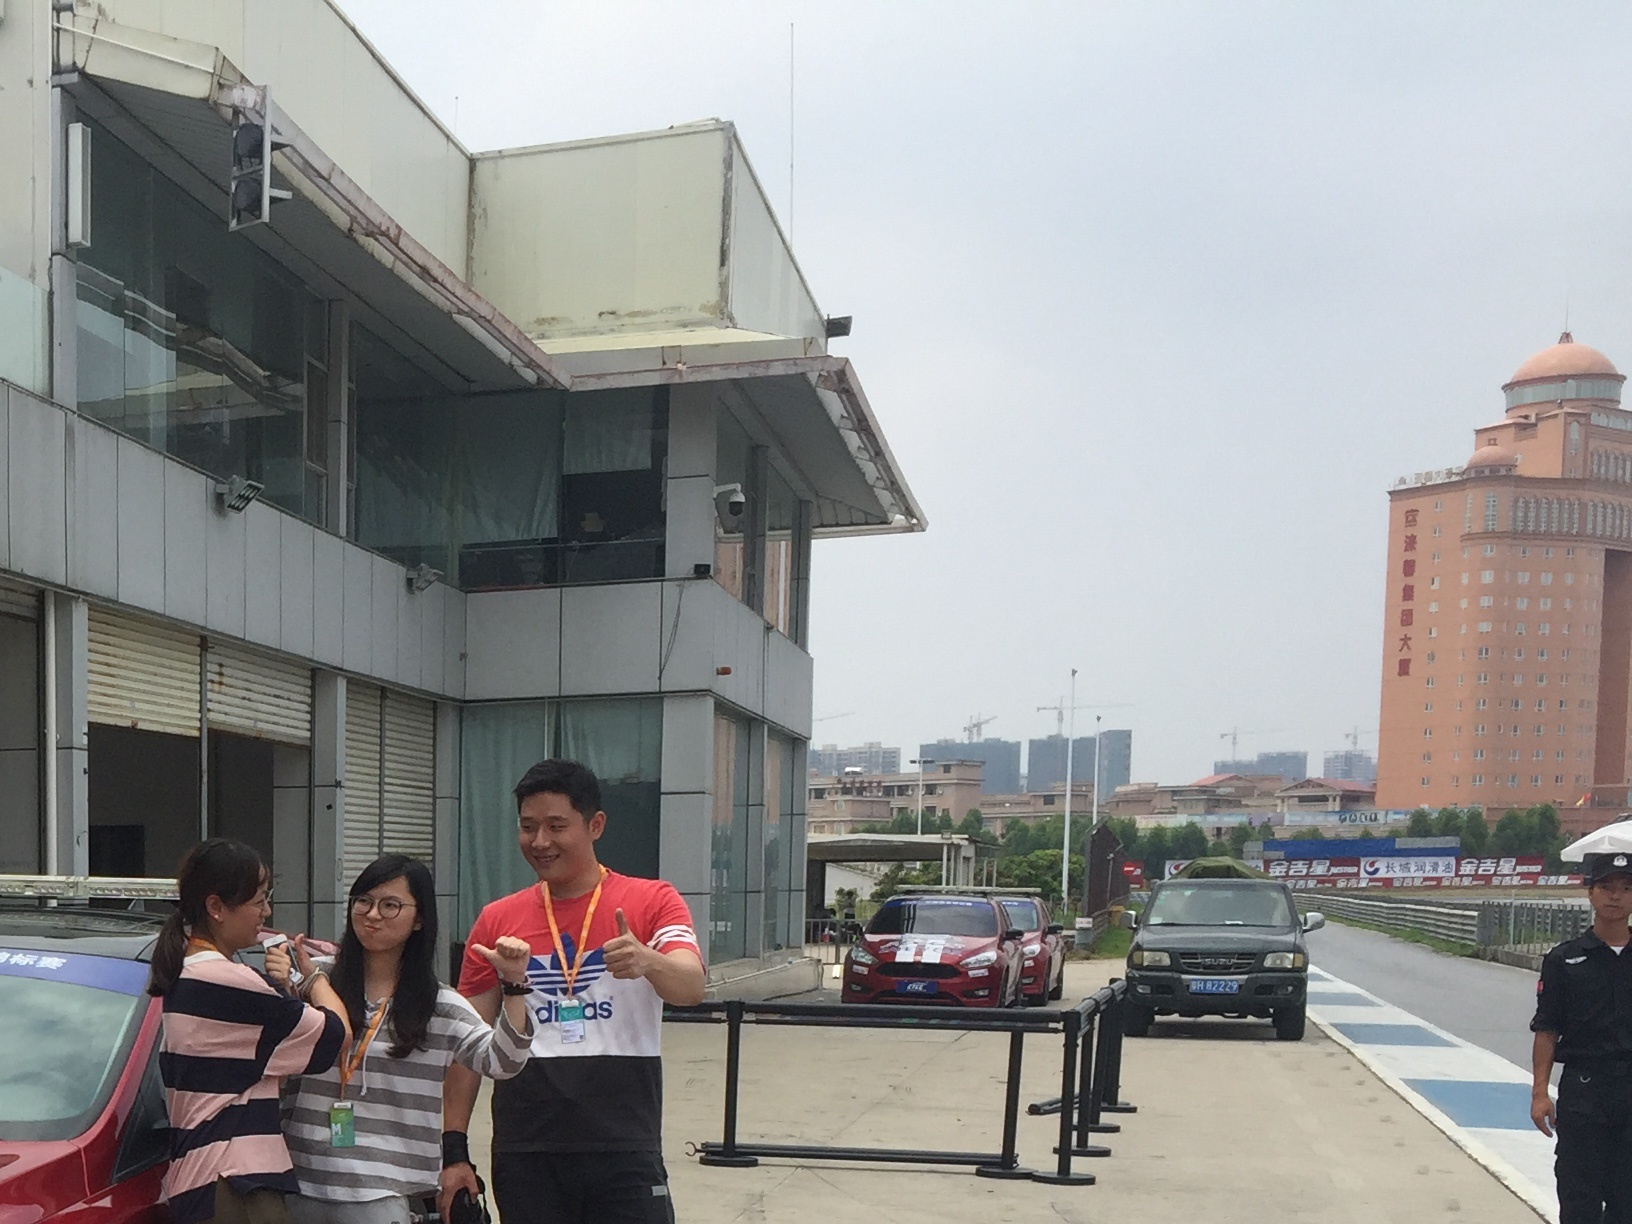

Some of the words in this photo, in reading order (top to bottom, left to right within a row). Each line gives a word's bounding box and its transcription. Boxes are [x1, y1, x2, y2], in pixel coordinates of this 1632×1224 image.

[1385, 861, 1454, 874] 长城润滑油
[1458, 857, 1516, 875] 金吉星
[1202, 958, 1234, 966] ISUZU
